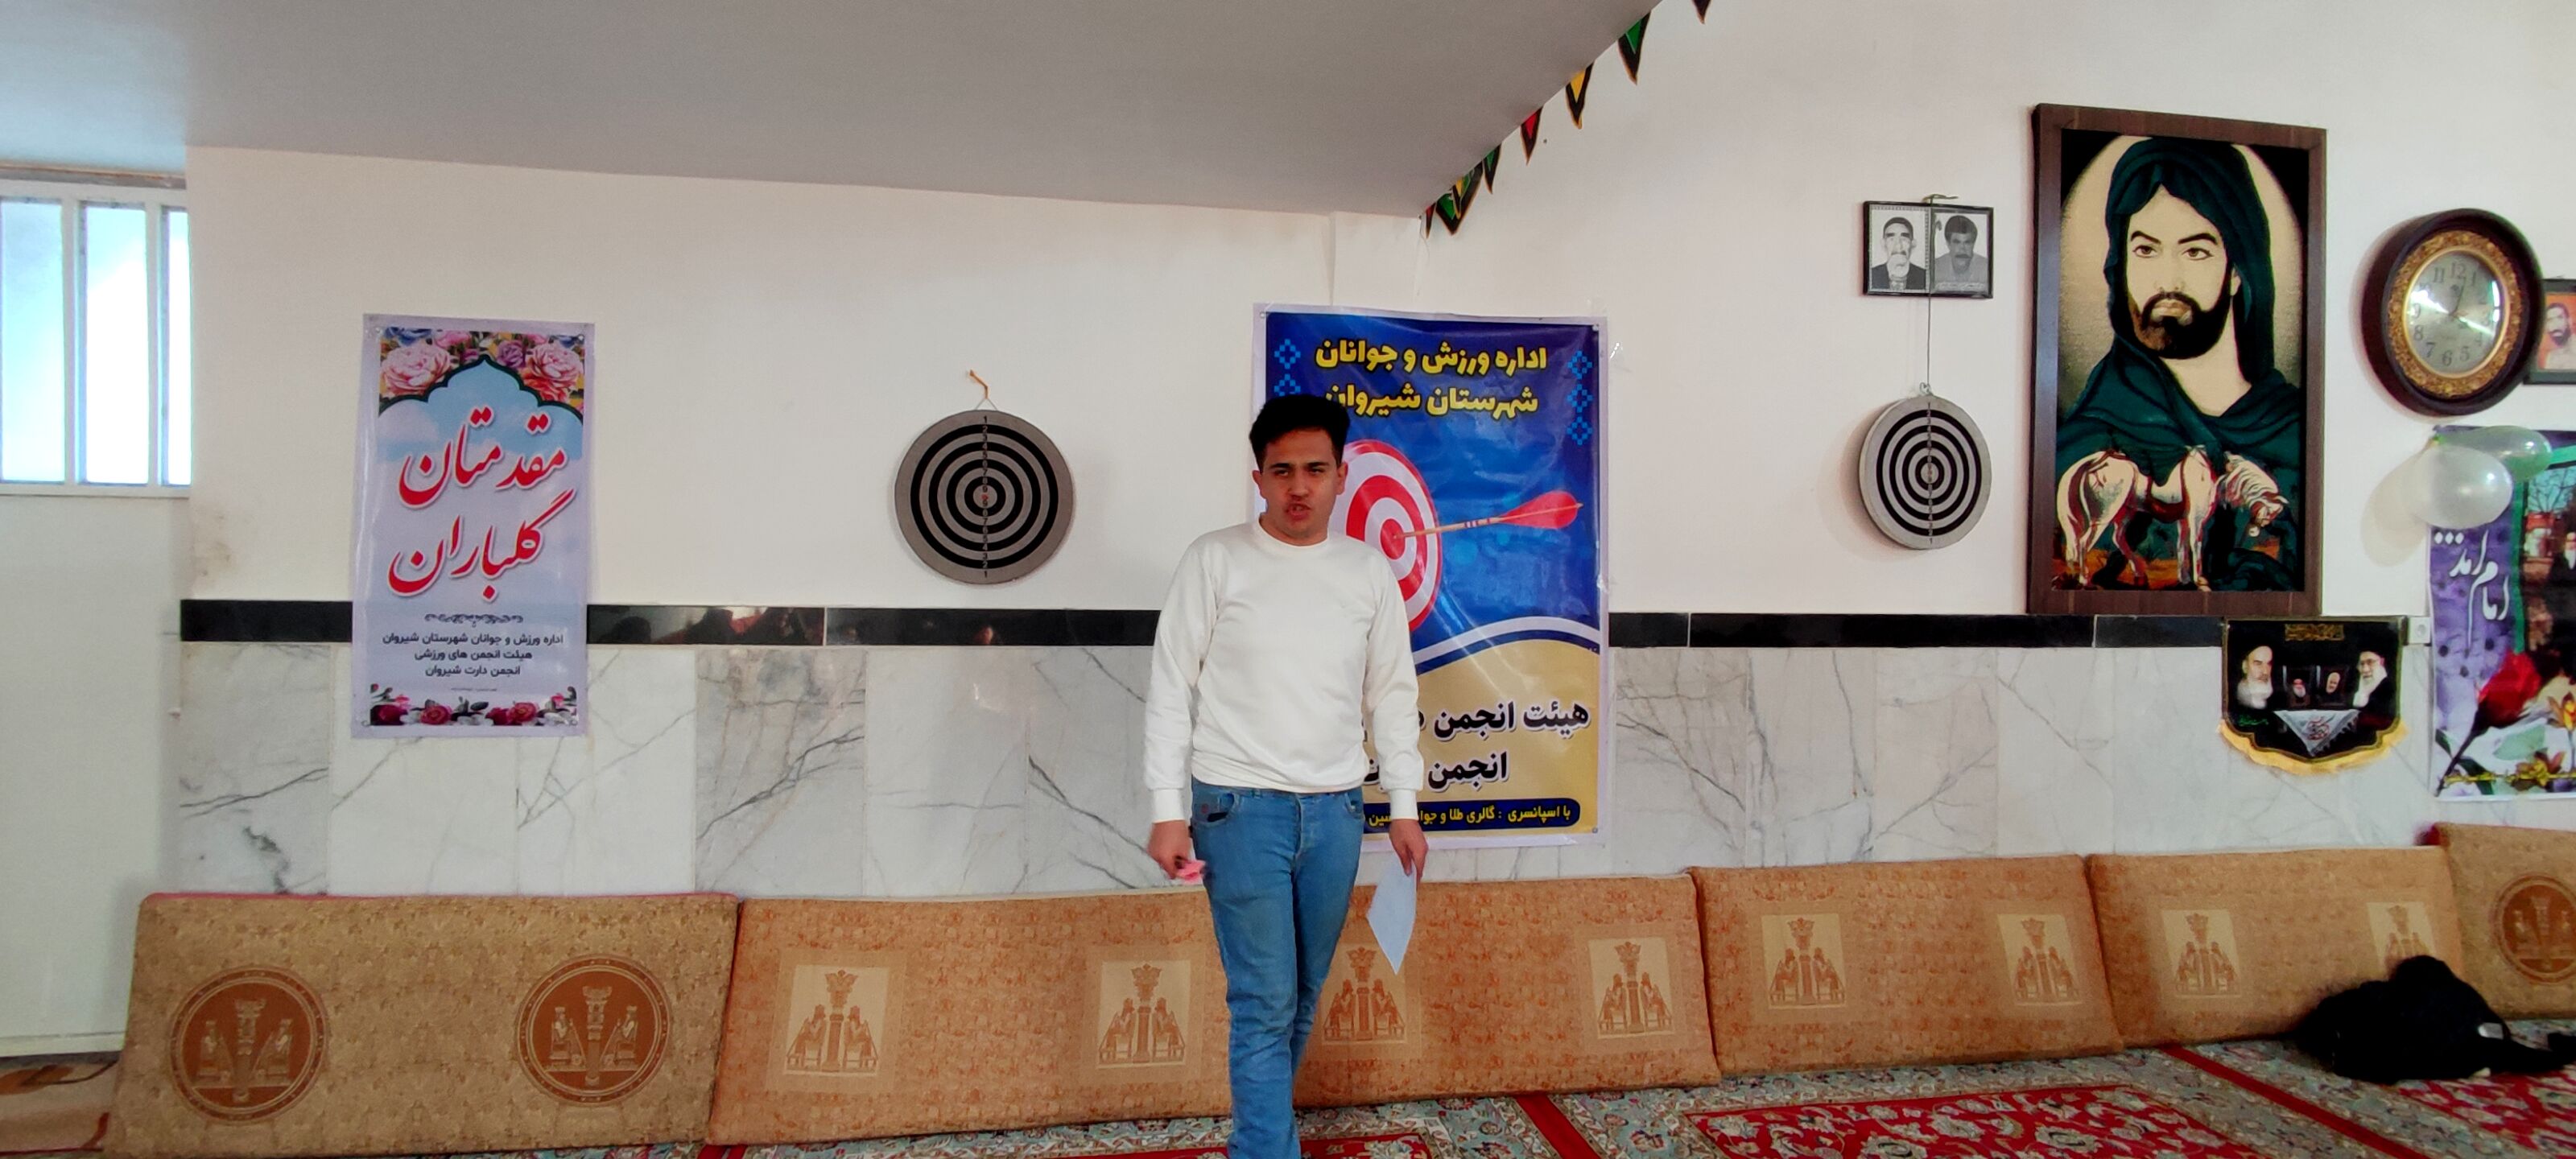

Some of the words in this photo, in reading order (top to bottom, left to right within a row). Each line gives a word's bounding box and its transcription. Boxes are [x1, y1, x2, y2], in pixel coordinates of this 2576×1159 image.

[1315, 339, 1398, 371] جوانان
[1403, 349, 1416, 373] و
[1422, 341, 1490, 375] ورزش
[1495, 346, 1546, 377] اداره
[1426, 386, 1538, 420] شهرستان
[399, 406, 566, 506] مقدمتان
[389, 488, 575, 600] گلباران
[382, 632, 419, 645] شیروان
[422, 632, 469, 645] شهرستان
[470, 633, 502, 645] جوانان
[504, 636, 511, 645] و
[513, 633, 541, 645] ورزش
[543, 633, 564, 646] اداره
[414, 648, 446, 661] ورزشی
[448, 649, 468, 661] های
[470, 650, 502, 661] انجمن
[503, 649, 533, 662] هیئت
[425, 665, 461, 677] شیروان
[464, 665, 488, 677] دارت
[489, 665, 521, 678] انجمن
[1434, 700, 1514, 738] انجمن
[1523, 701, 1589, 736] هیئت
[1427, 751, 1508, 790] انجمن
[1439, 812, 1447, 824] و
[1449, 808, 1464, 821] طلا
[1466, 804, 1496, 824] گالری
[1507, 805, 1560, 824] اسپانسری
[1562, 805, 1571, 821] با
[1368, 815, 1392, 828] سین
